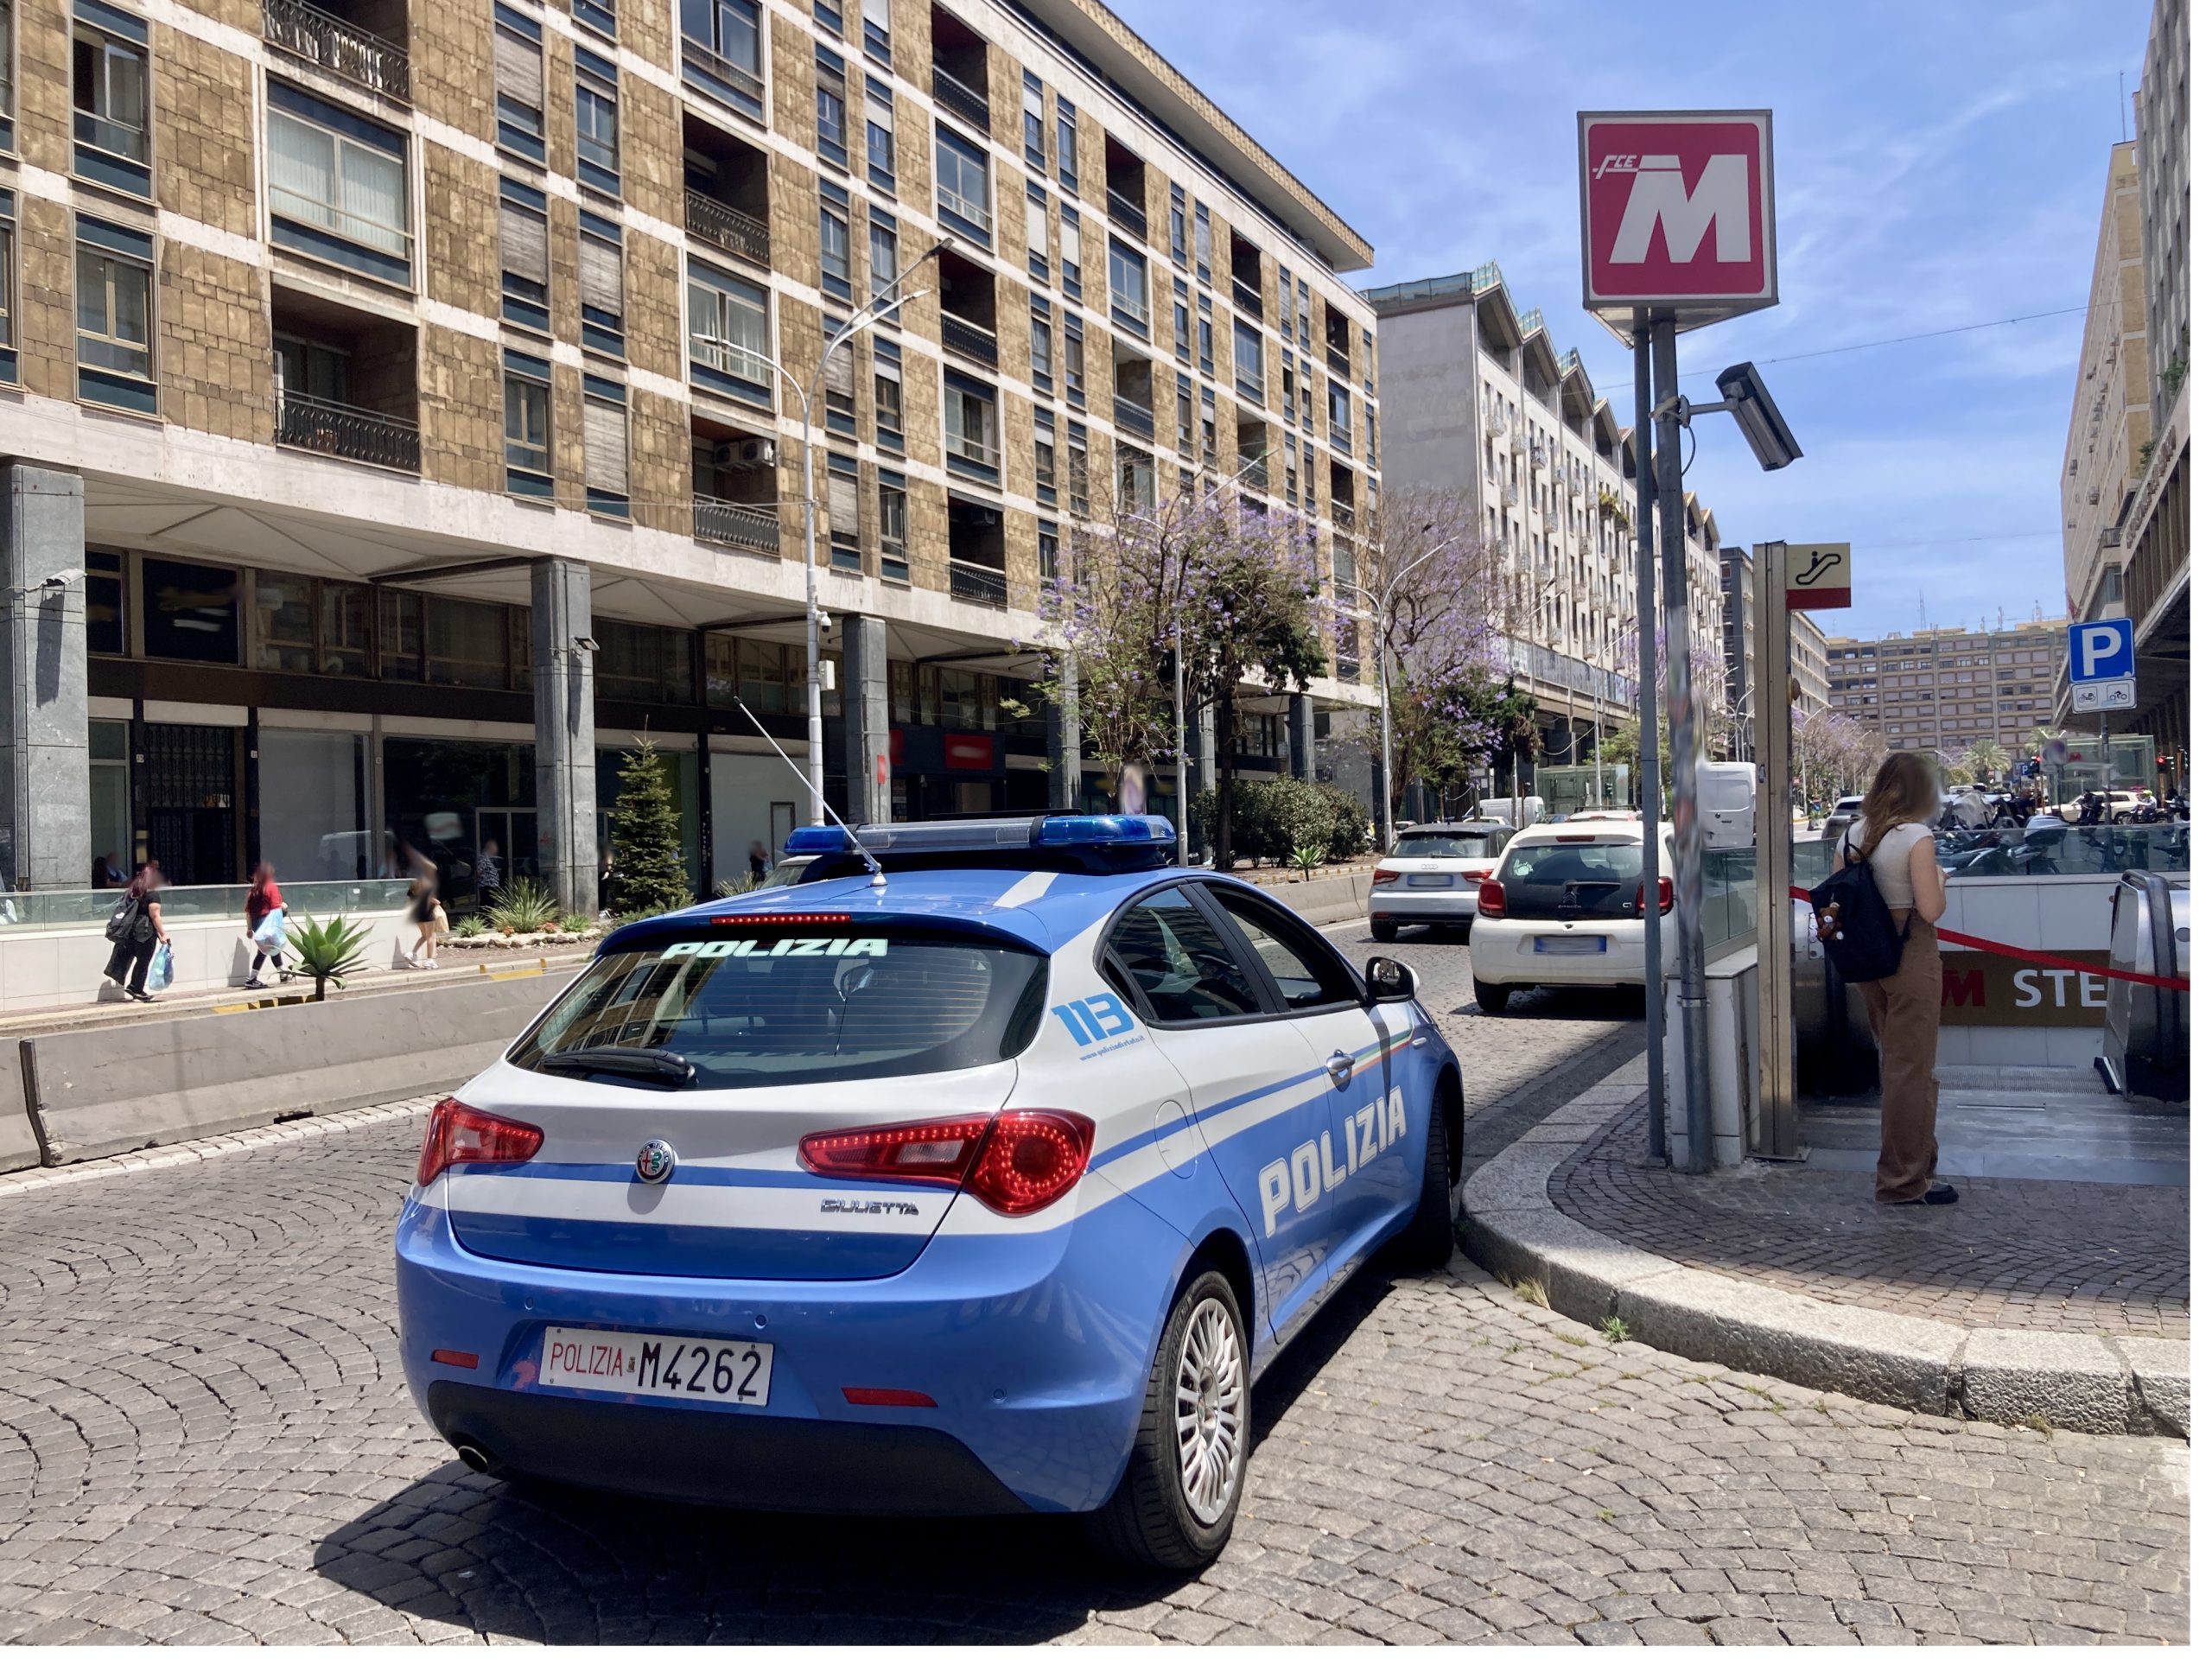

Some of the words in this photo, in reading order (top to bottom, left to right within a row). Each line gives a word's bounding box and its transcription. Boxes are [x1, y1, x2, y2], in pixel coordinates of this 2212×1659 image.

[1592, 155, 1637, 179] FCE
[1609, 154, 1751, 264] M
[2082, 626, 2122, 677] P
[660, 938, 888, 960] POLIZIA
[1941, 969, 1986, 1007] M
[1051, 992, 1135, 1046] 113
[1259, 1085, 1407, 1238] POLIZIA
[821, 1198, 919, 1216] GIULIETTA
[550, 1342, 623, 1377] POLIZIA
[637, 1342, 762, 1397] M4262
